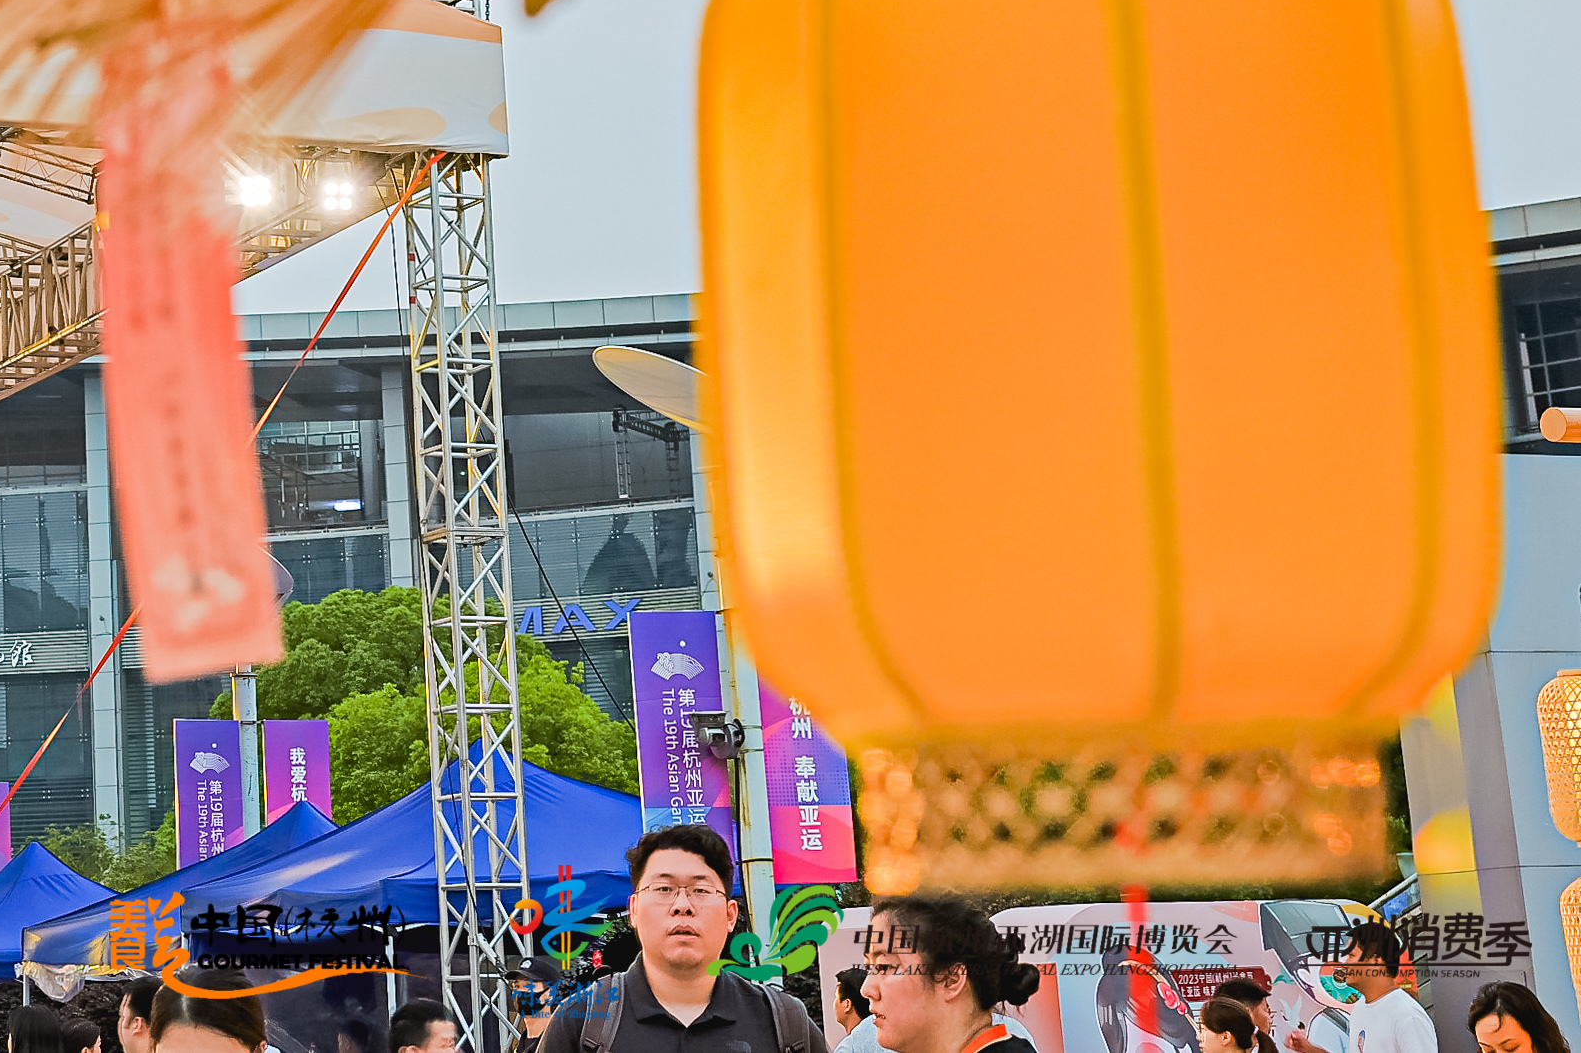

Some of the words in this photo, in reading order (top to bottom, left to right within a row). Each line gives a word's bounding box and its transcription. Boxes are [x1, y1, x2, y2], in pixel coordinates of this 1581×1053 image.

[662, 688, 675, 715] The
[664, 720, 679, 750] 19th
[289, 747, 308, 802] 我爱杭
[666, 753, 682, 793] Asian
[197, 780, 207, 801] The
[794, 755, 823, 851] 奉献亚运
[198, 805, 209, 828] 19th
[199, 830, 210, 861] Asian
